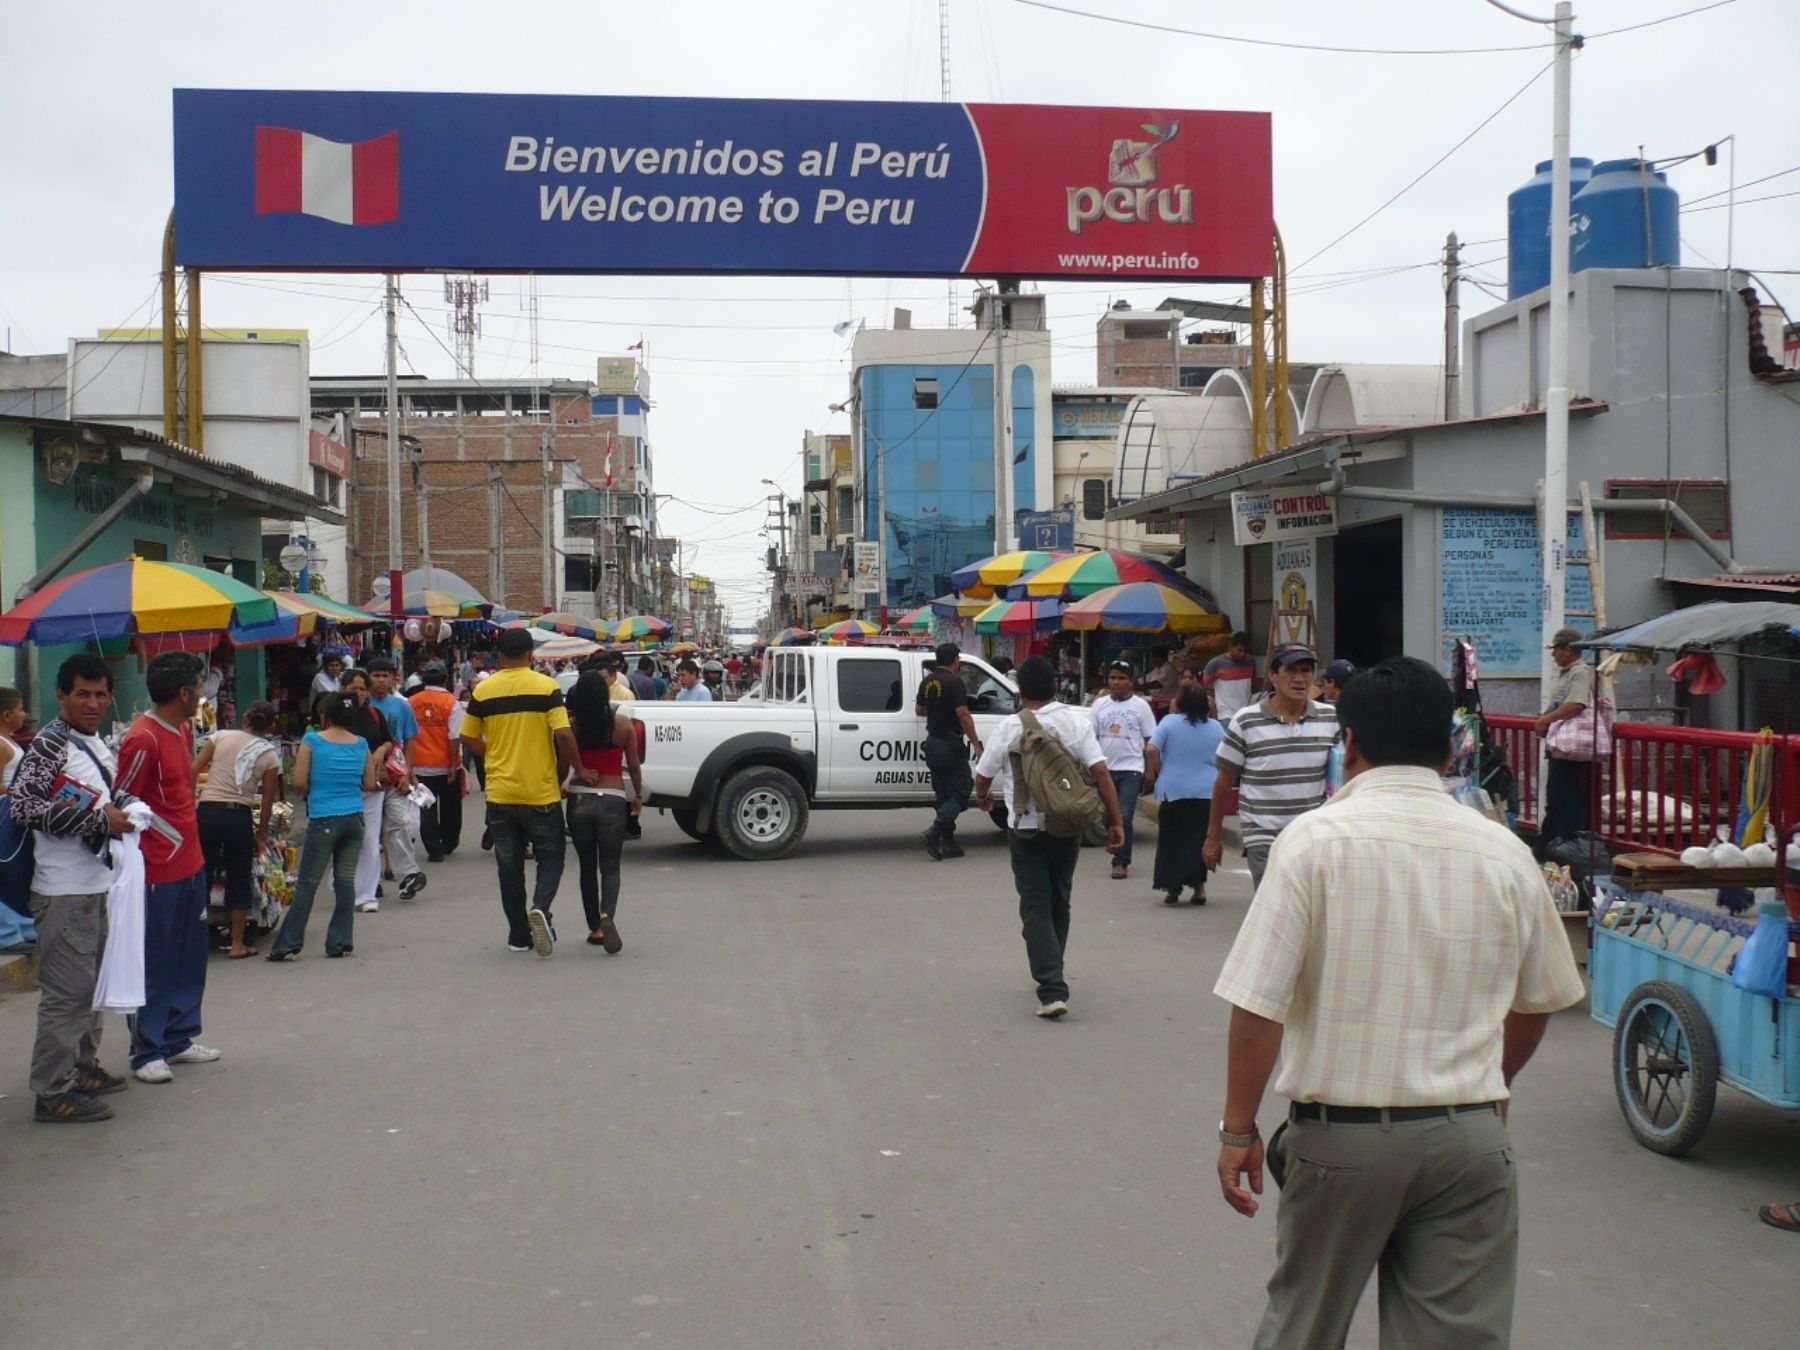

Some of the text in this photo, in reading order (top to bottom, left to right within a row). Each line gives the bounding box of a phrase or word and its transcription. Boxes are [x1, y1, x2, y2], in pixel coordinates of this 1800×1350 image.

[504, 136, 951, 178] Bienvenidos al Perú
[539, 185, 915, 225] Welcome to Peru
[1065, 184, 1195, 234] perú
[1058, 251, 1200, 272] www.peru.info
[1237, 500, 1273, 513] ADUANAS
[1273, 494, 1331, 516] CONTROL
[1443, 518, 1457, 528] DE
[1460, 518, 1516, 528] VEHICULOS
[1443, 528, 1538, 539] SEGUN EL CONVENI
[1276, 549, 1311, 571] ADUANAS
[874, 771, 915, 784] AGUAS
